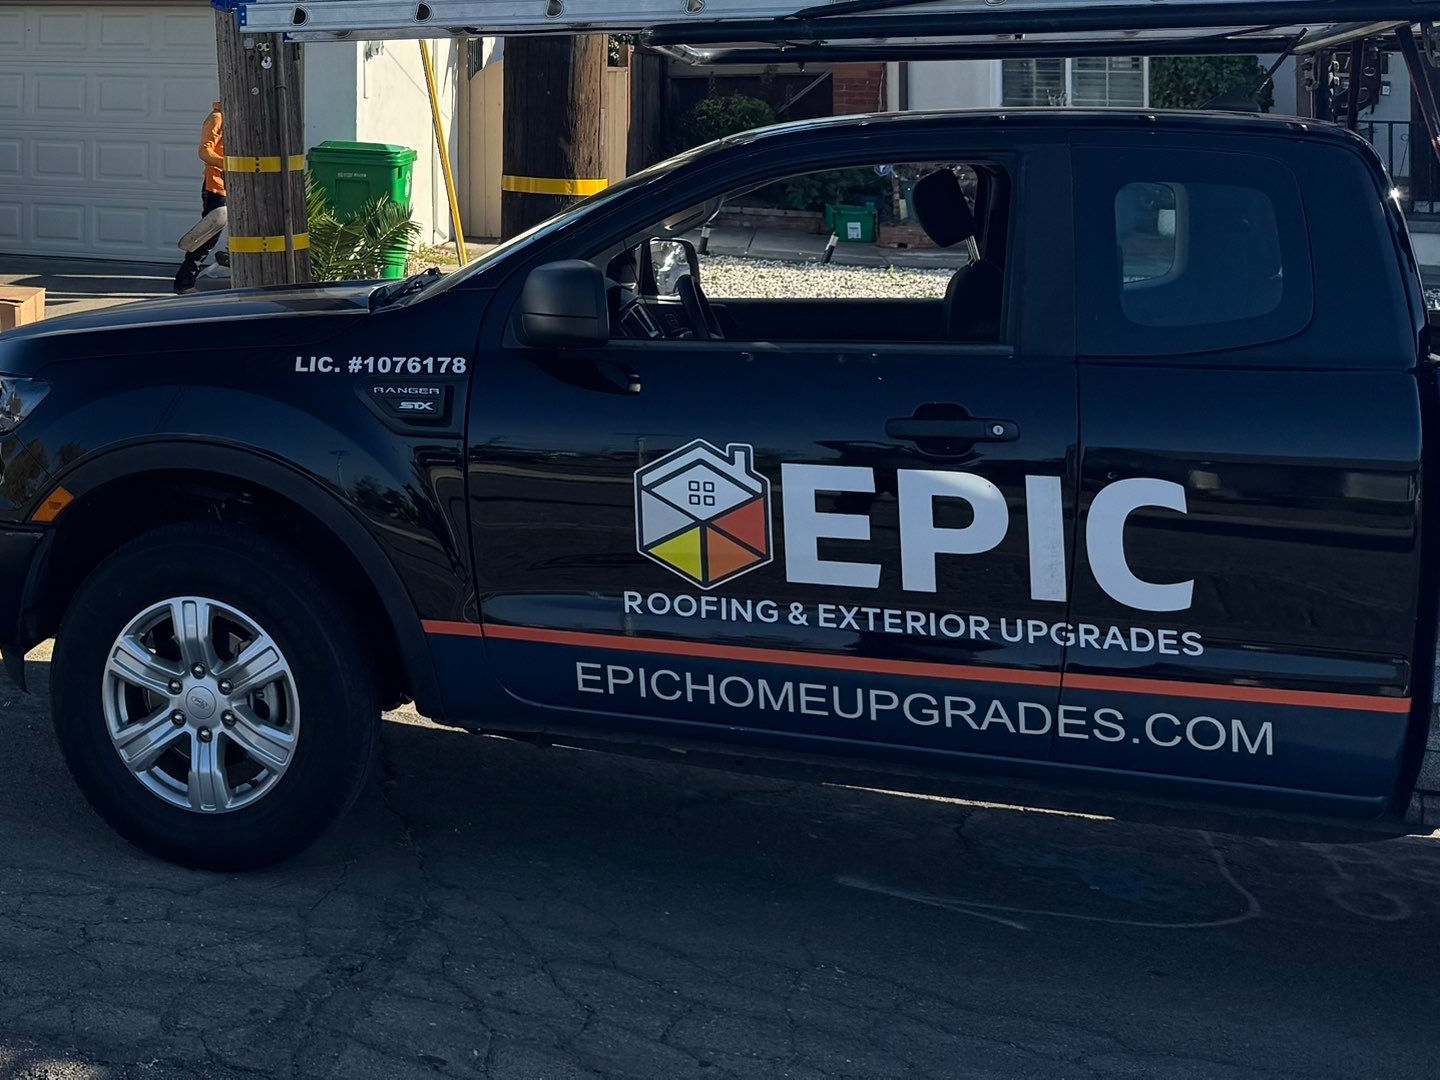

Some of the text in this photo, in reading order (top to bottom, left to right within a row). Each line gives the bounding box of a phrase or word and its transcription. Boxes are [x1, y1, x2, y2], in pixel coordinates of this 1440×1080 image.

[295, 356, 467, 374] LIC. #1076178
[373, 387, 440, 395] RANGER
[781, 463, 1195, 612] EPIC
[623, 590, 1205, 656] ROOFING & EXTERIOR UPGRADES
[574, 661, 1274, 757] EPICHOMEUPGRADES.COM
